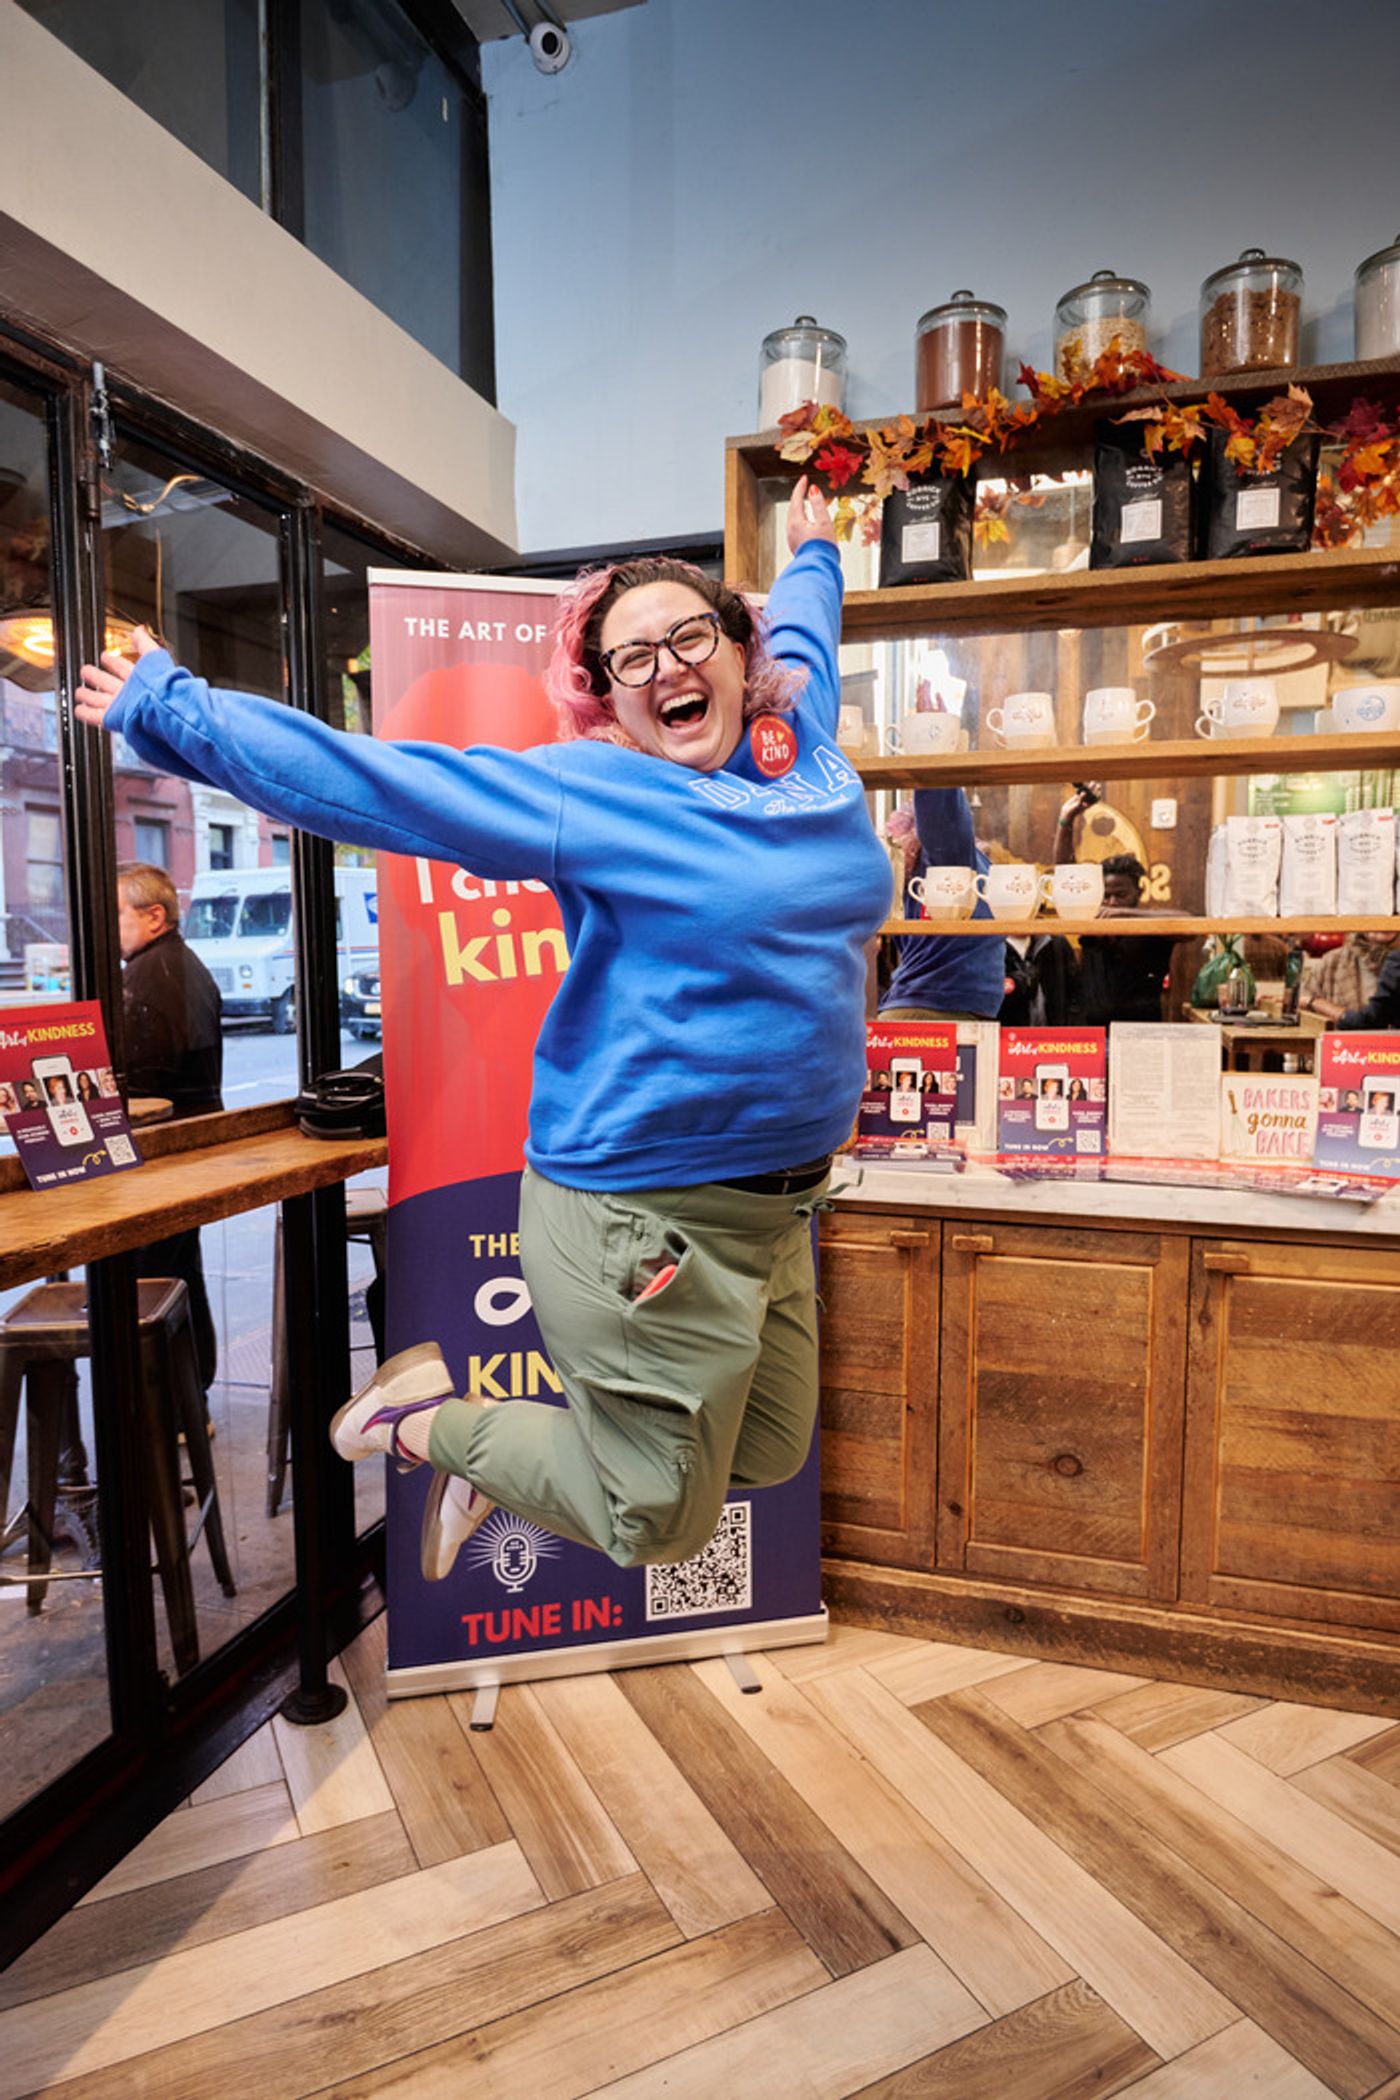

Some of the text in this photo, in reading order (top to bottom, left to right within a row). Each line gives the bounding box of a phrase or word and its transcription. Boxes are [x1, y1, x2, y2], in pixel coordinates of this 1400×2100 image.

[404, 617, 547, 643] THE ART OF
[761, 730, 776, 745] BE
[762, 744, 789, 763] KIND
[415, 857, 434, 904] I
[438, 908, 572, 985] kin
[27, 1022, 96, 1043] KINDNESS
[893, 1036, 949, 1049] KINDNESS
[1038, 1041, 1098, 1054] KINDNESS
[1367, 1051, 1400, 1065] KIND
[1243, 1087, 1311, 1110] BAKERS
[1247, 1112, 1307, 1136] gonna
[1256, 1130, 1311, 1156] BAKE
[468, 1232, 520, 1259] THE
[468, 1350, 565, 1400] KIN
[461, 1595, 624, 1646] TUNE IN:
